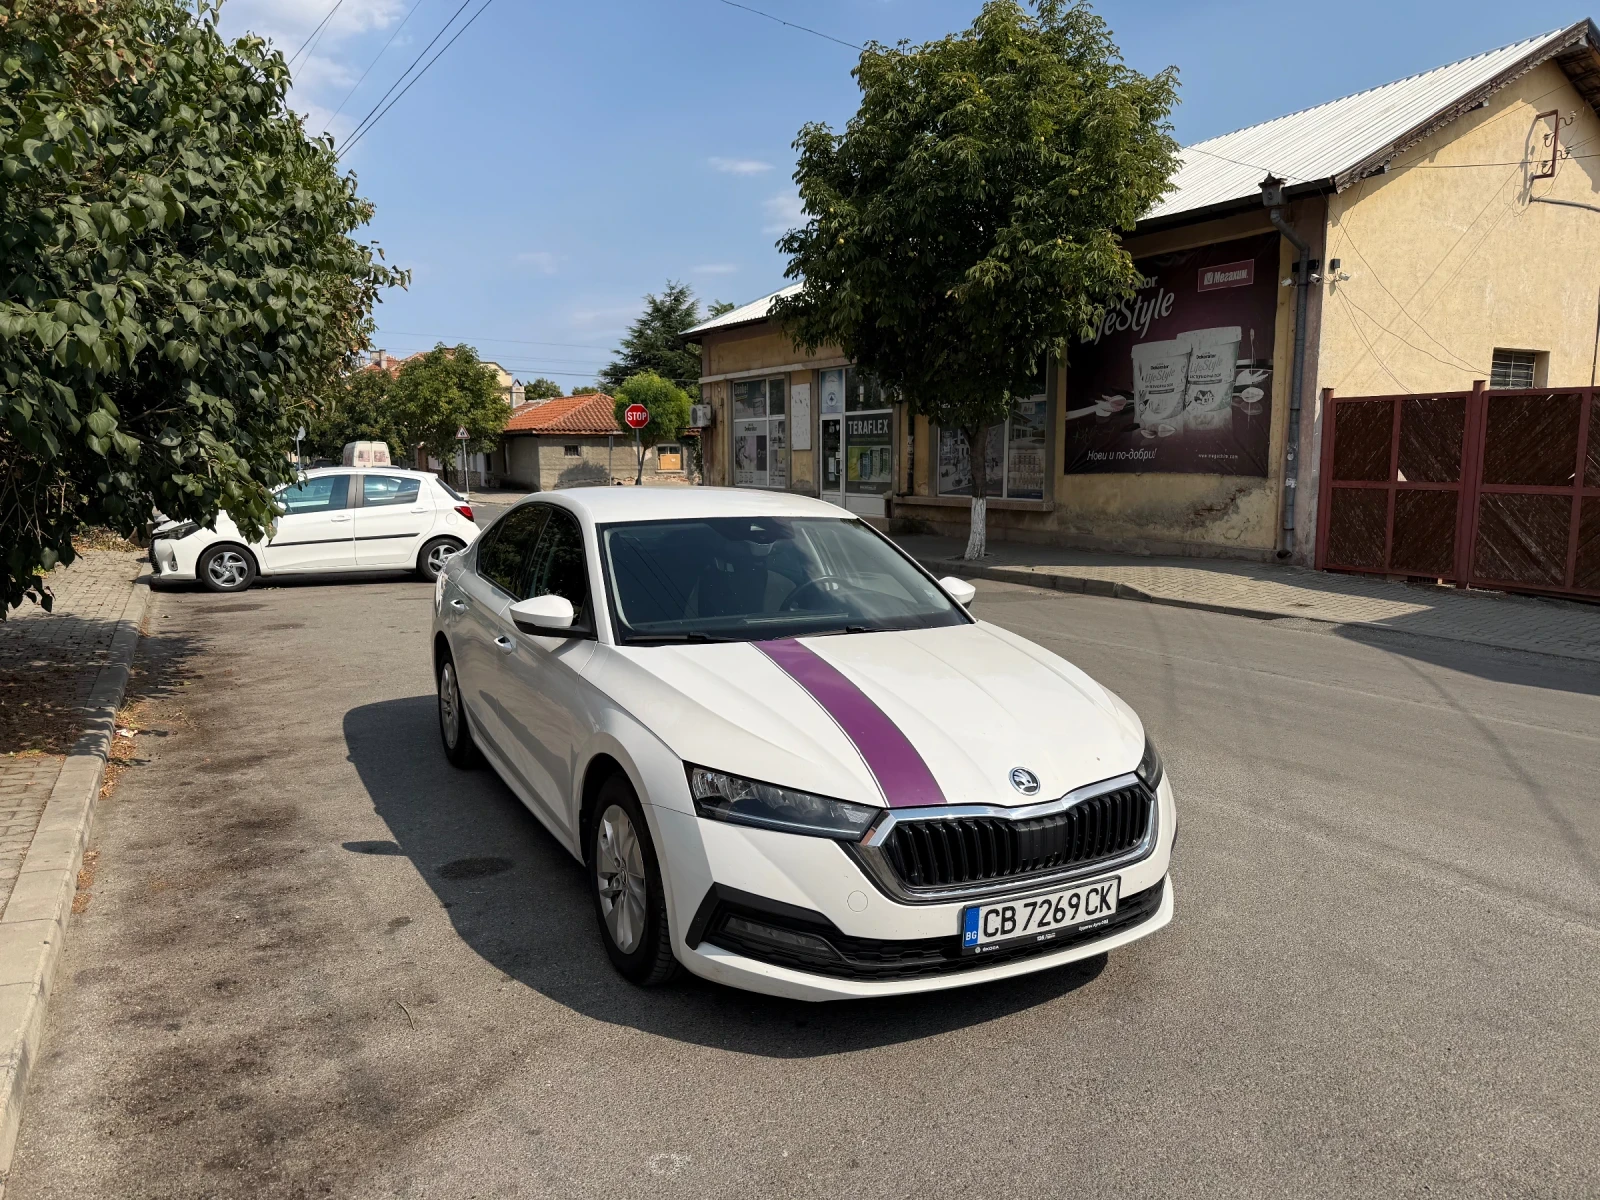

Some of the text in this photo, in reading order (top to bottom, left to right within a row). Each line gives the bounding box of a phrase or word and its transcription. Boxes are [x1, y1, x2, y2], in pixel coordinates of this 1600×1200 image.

[1080, 288, 1175, 346] feStyle
[627, 411, 647, 421] STOP
[848, 419, 889, 435] TERAFLEX
[1087, 448, 1158, 462] Нови и по-добри!
[983, 883, 1113, 937] CB 7269 CK
[965, 930, 978, 941] BG
